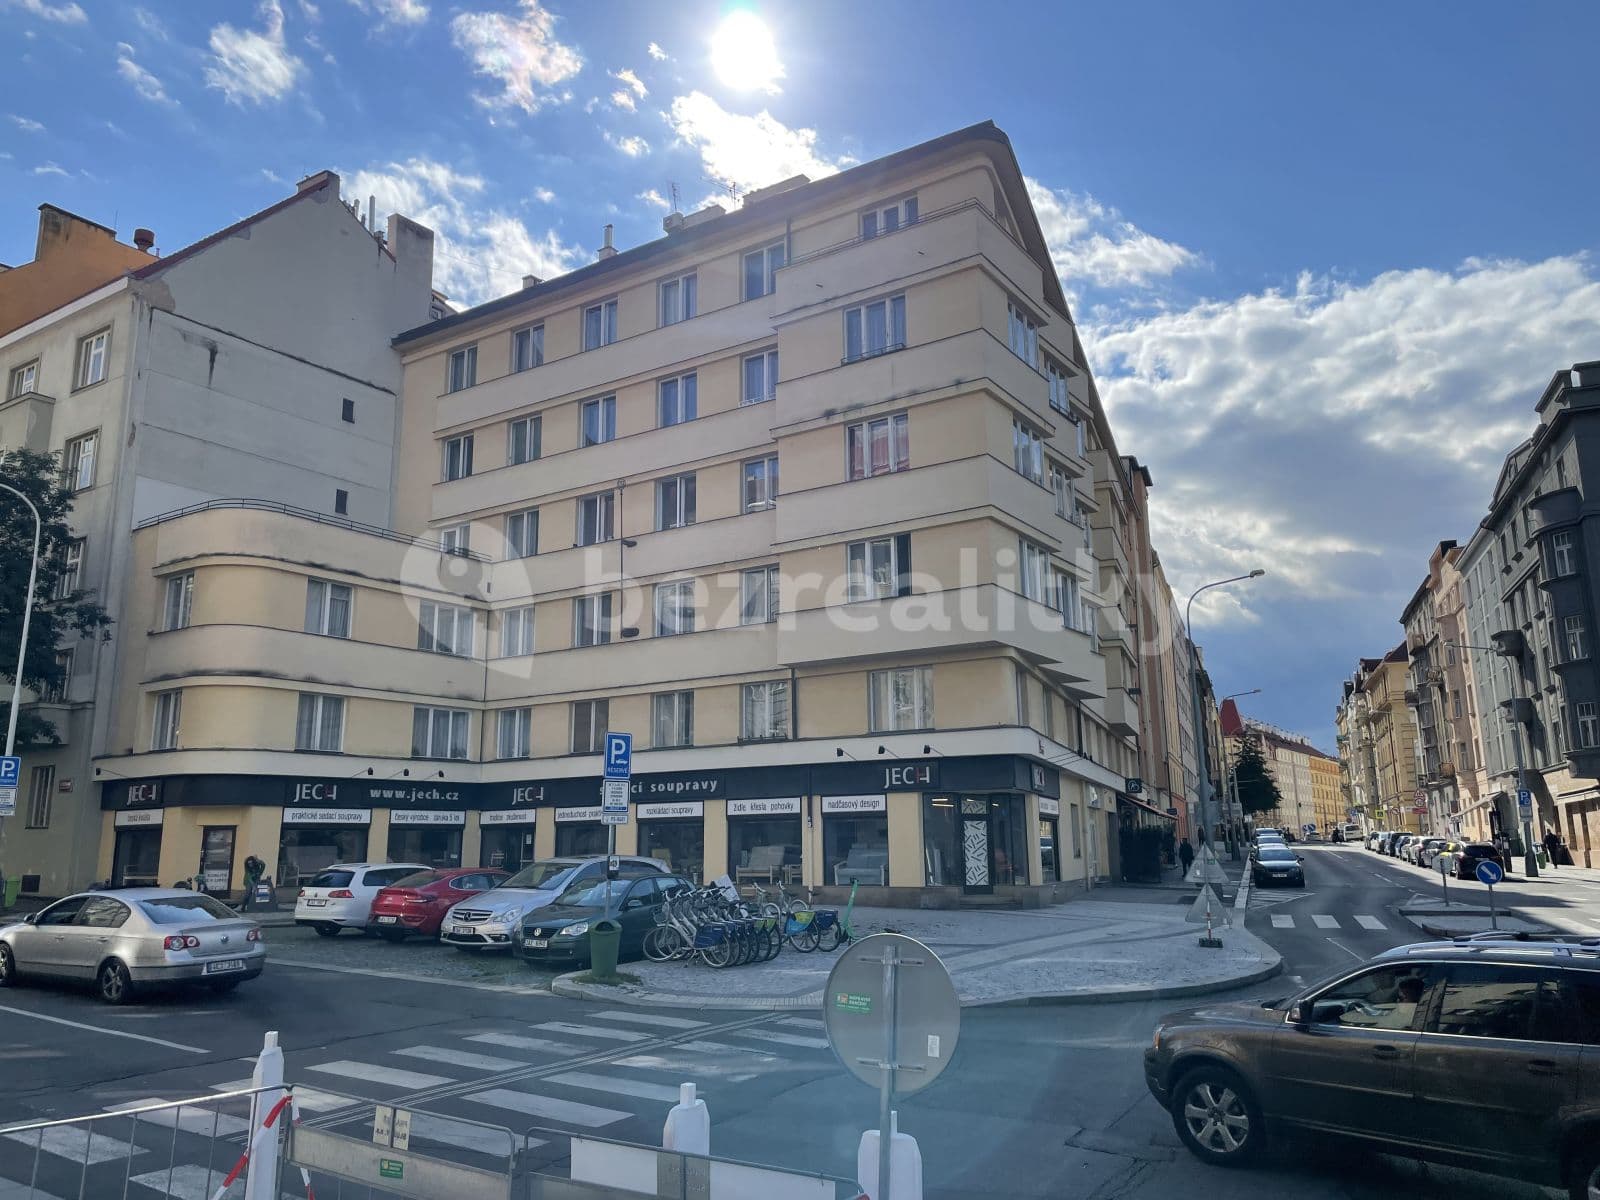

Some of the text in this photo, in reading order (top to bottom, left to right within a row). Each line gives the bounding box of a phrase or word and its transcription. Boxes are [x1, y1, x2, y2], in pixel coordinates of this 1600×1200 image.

[610, 738, 627, 765] P
[1, 759, 16, 777] P
[884, 766, 930, 789] JECH
[650, 779, 718, 794] soupravy
[369, 787, 459, 802] www.jech.cz
[770, 801, 794, 811] pohovky
[827, 799, 880, 809] nadčasový design
[291, 811, 318, 821] praktické
[337, 812, 363, 822] soupravy
